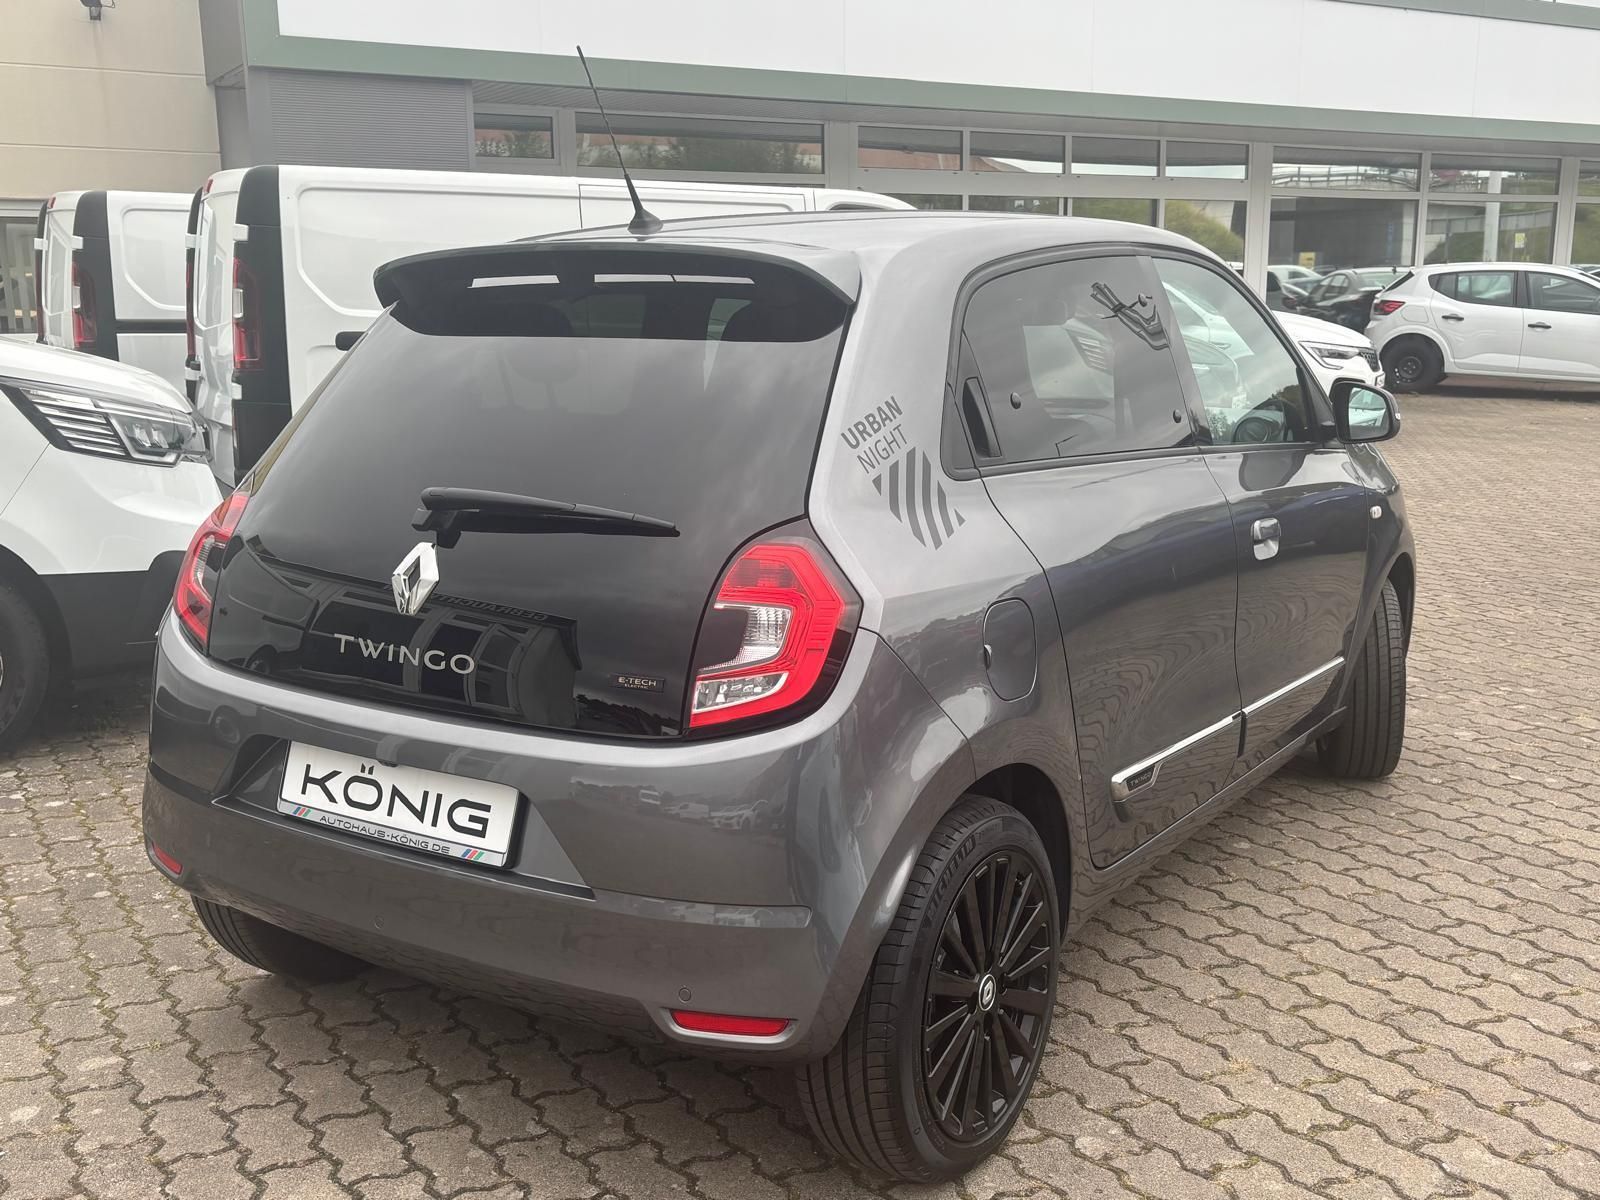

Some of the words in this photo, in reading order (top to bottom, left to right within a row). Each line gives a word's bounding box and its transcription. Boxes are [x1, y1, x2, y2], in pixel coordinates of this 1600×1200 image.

[841, 396, 903, 449] URBAN
[857, 424, 907, 474] NIGHT
[334, 633, 475, 675] TWINGO
[618, 676, 657, 687] E-TECH
[301, 763, 492, 838] KÖNIG
